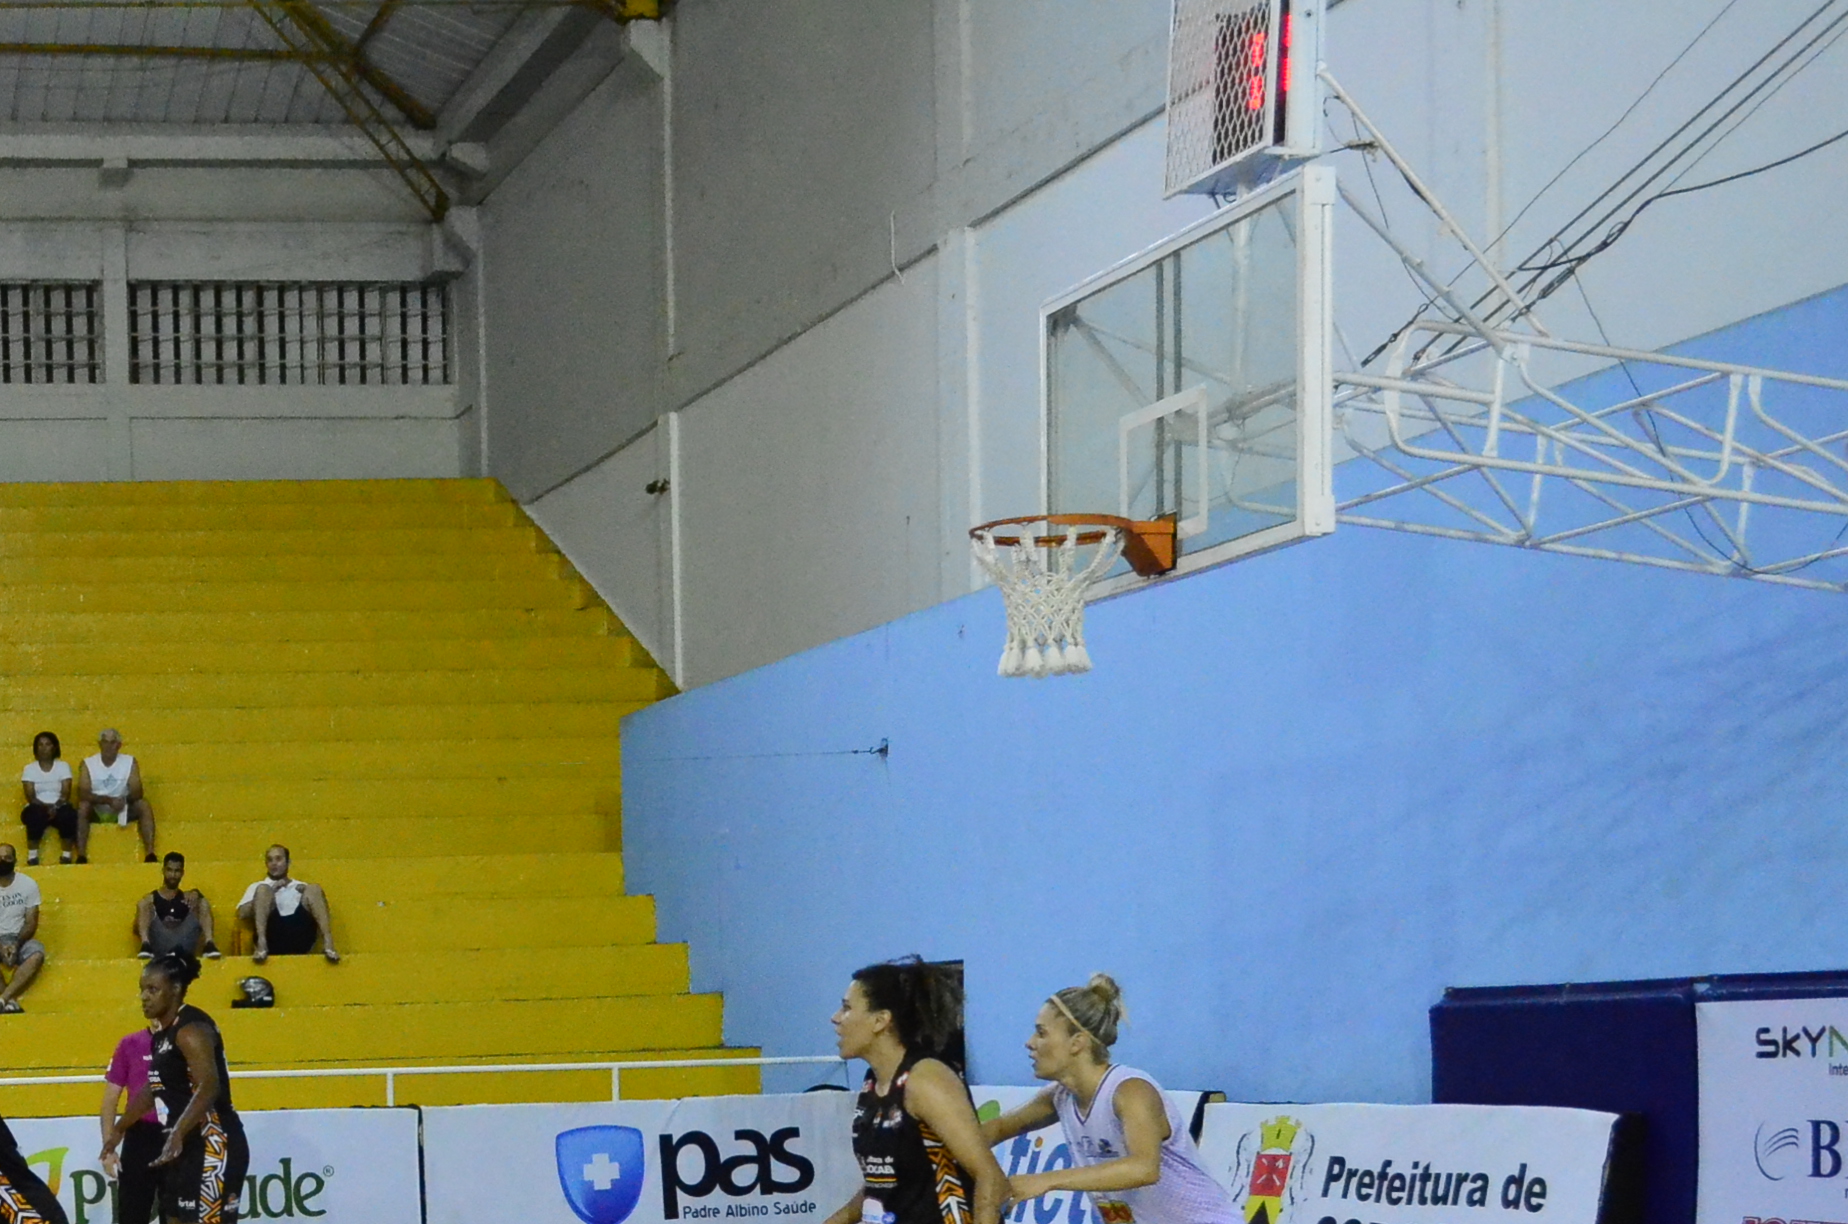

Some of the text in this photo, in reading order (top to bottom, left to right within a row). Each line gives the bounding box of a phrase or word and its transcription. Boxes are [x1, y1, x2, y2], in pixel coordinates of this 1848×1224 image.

[659, 1126, 815, 1220] pas
[1321, 1156, 1547, 1213] Prefeitura de
[682, 1200, 817, 1219] Padre Albino Saúde
